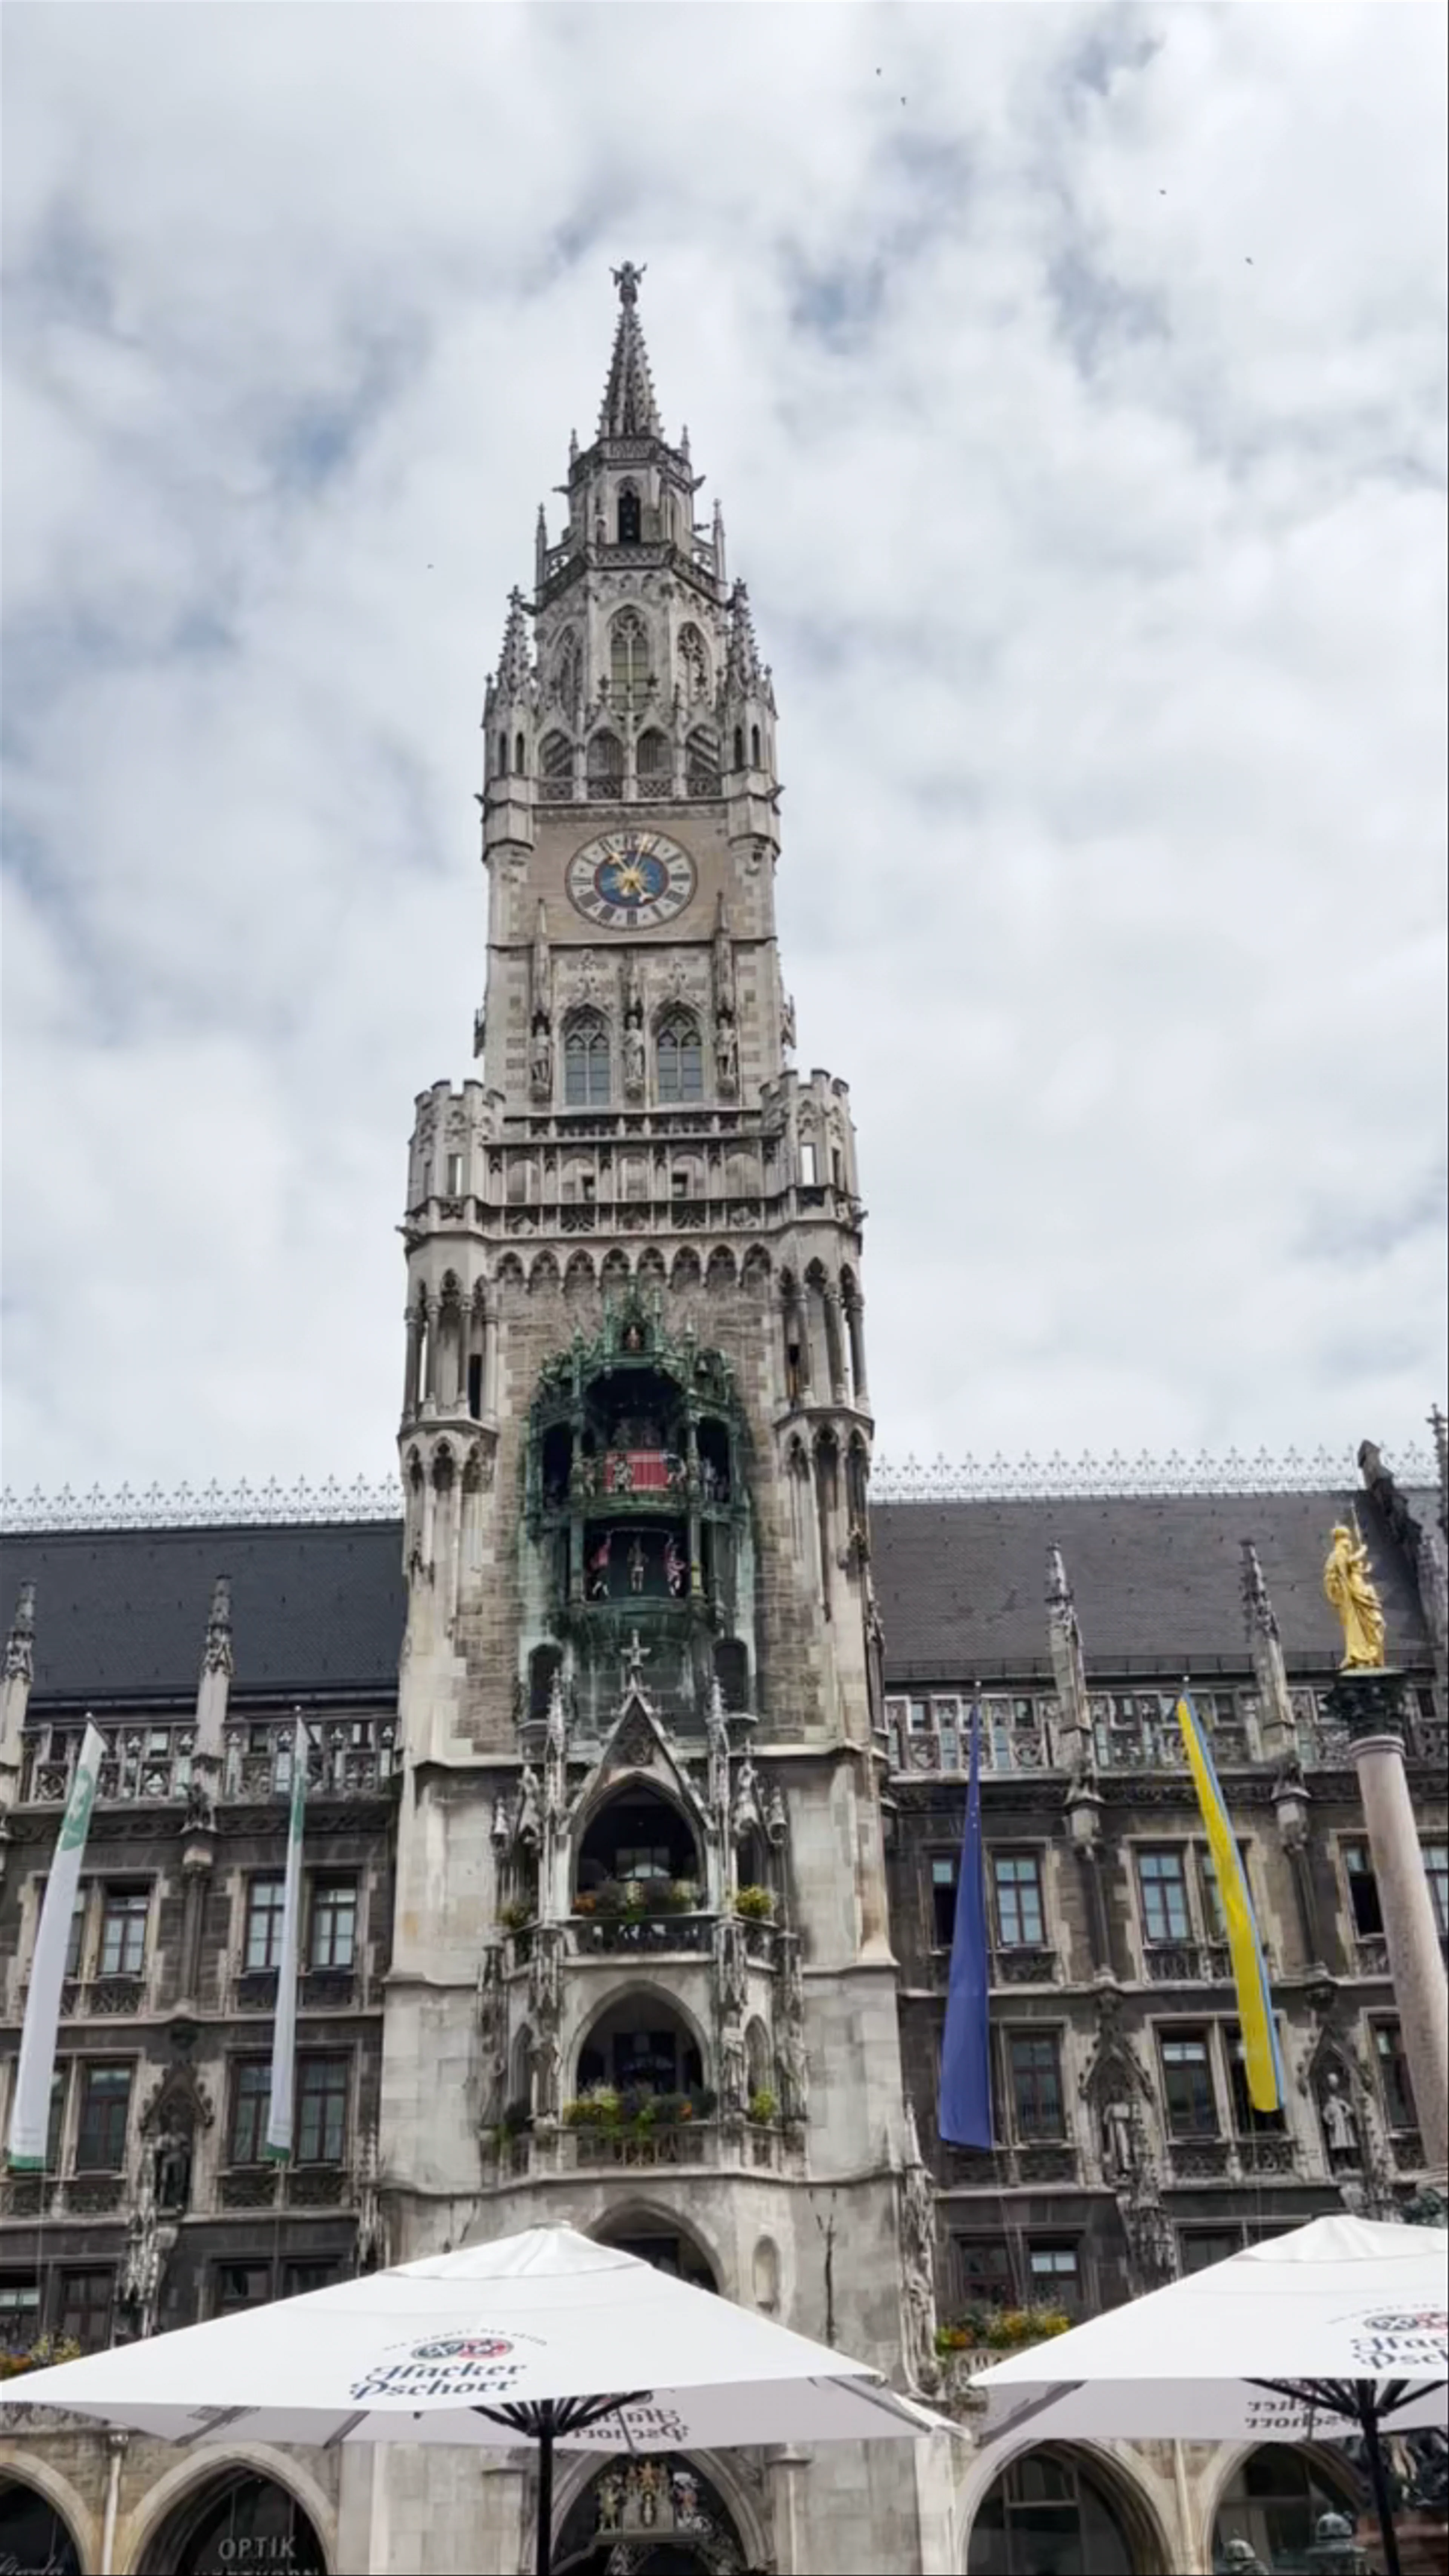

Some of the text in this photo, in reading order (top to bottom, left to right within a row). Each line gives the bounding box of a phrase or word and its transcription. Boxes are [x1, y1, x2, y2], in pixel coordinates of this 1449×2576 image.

[365, 2362, 526, 2381] Hacker
[350, 2379, 518, 2400] Pschorr
[218, 2536, 297, 2560] OPTIK
